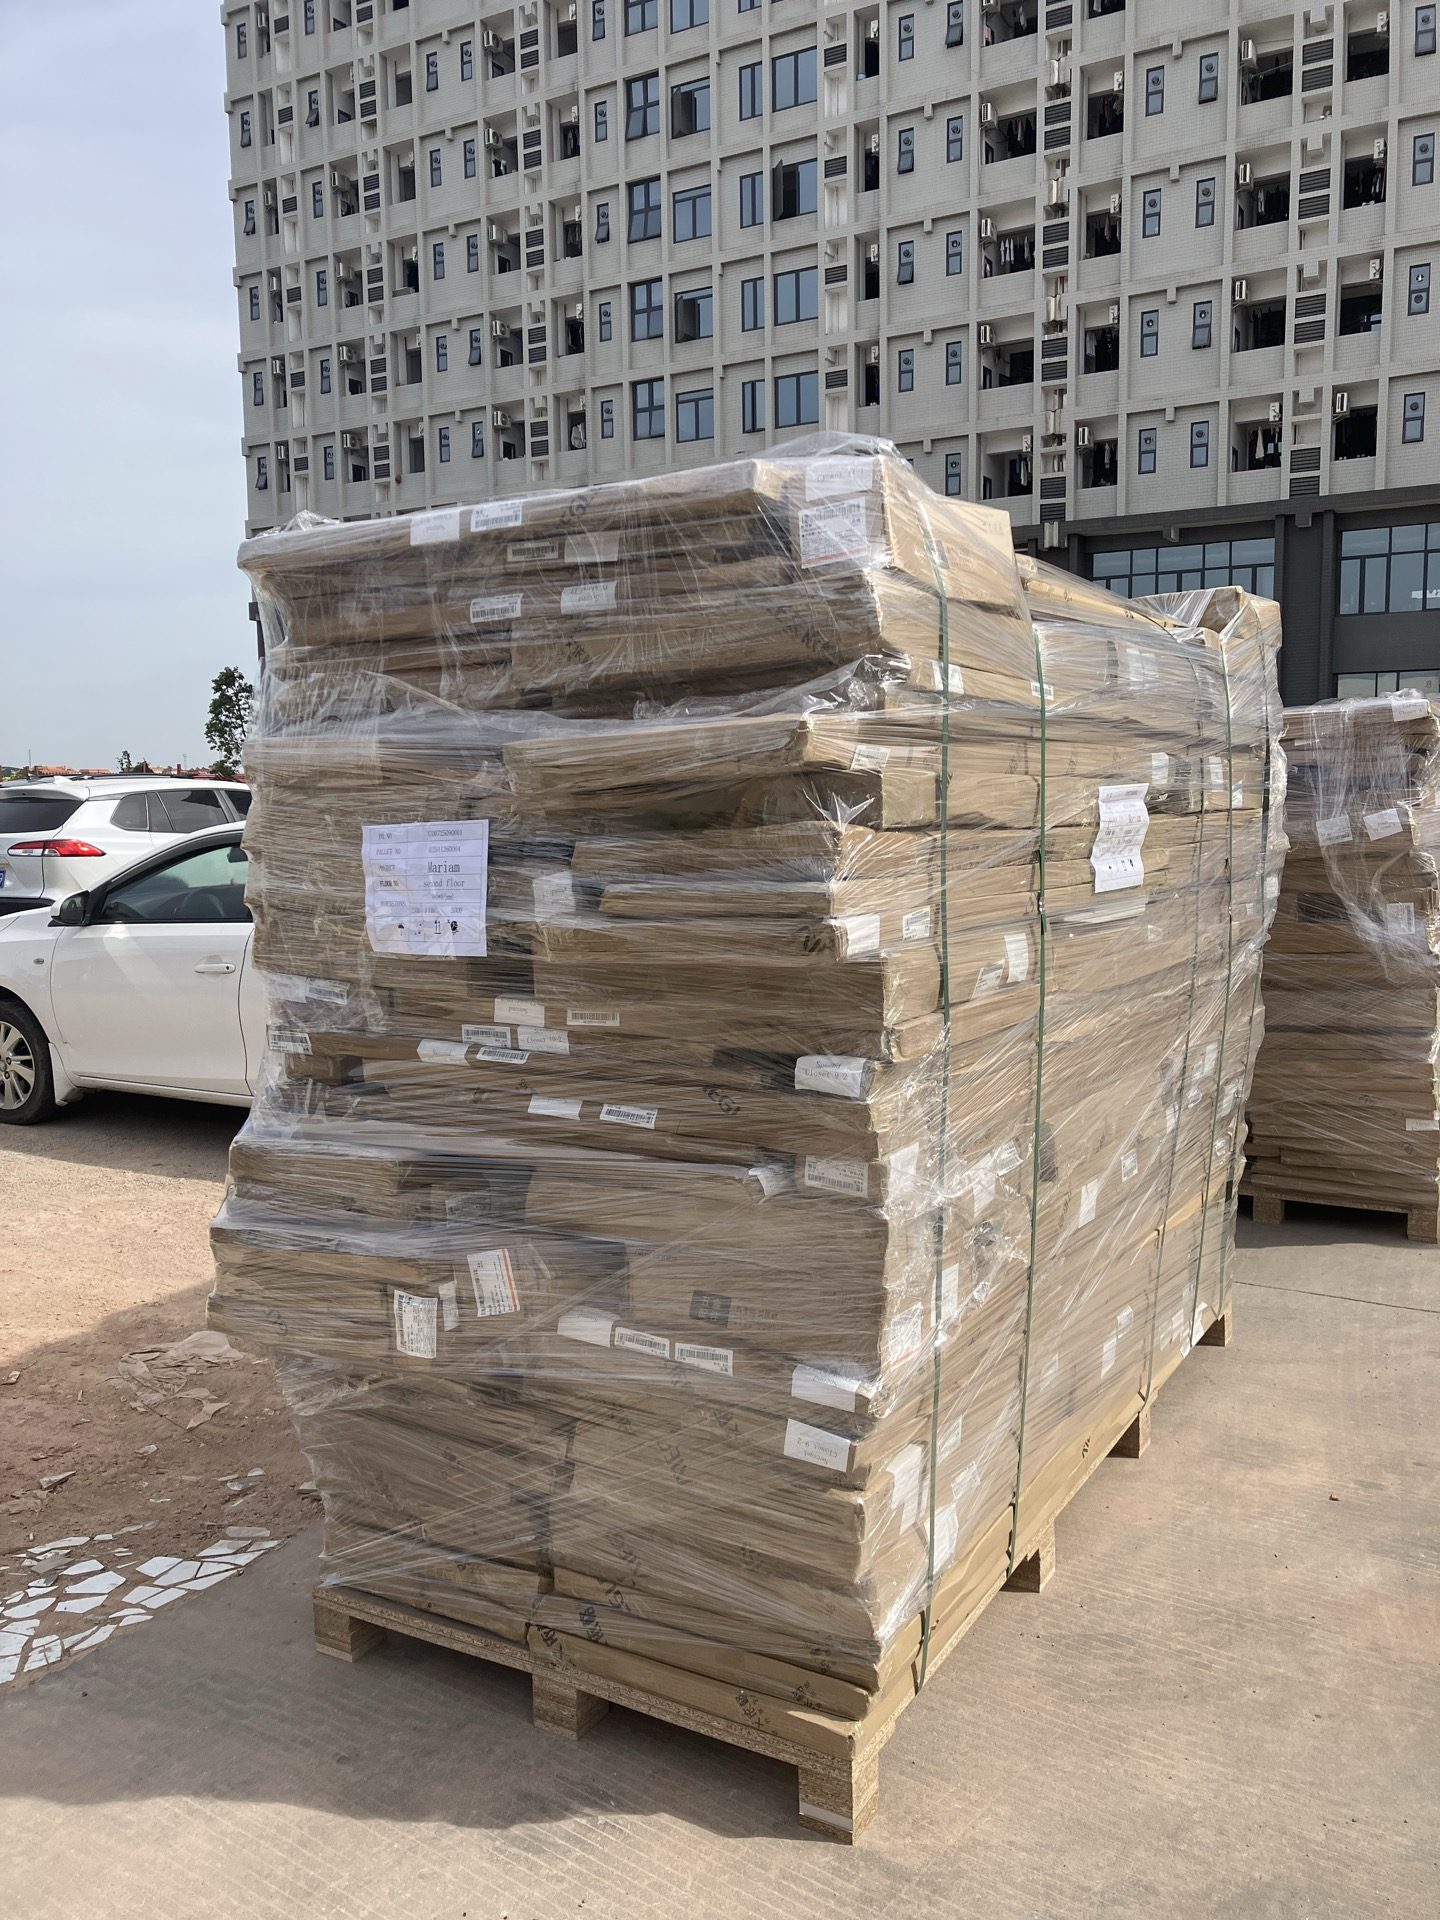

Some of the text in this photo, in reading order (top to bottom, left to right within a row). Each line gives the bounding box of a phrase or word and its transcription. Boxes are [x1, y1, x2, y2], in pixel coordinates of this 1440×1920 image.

[427, 861, 461, 873] Mariam
[423, 877, 465, 888] secnd floor
